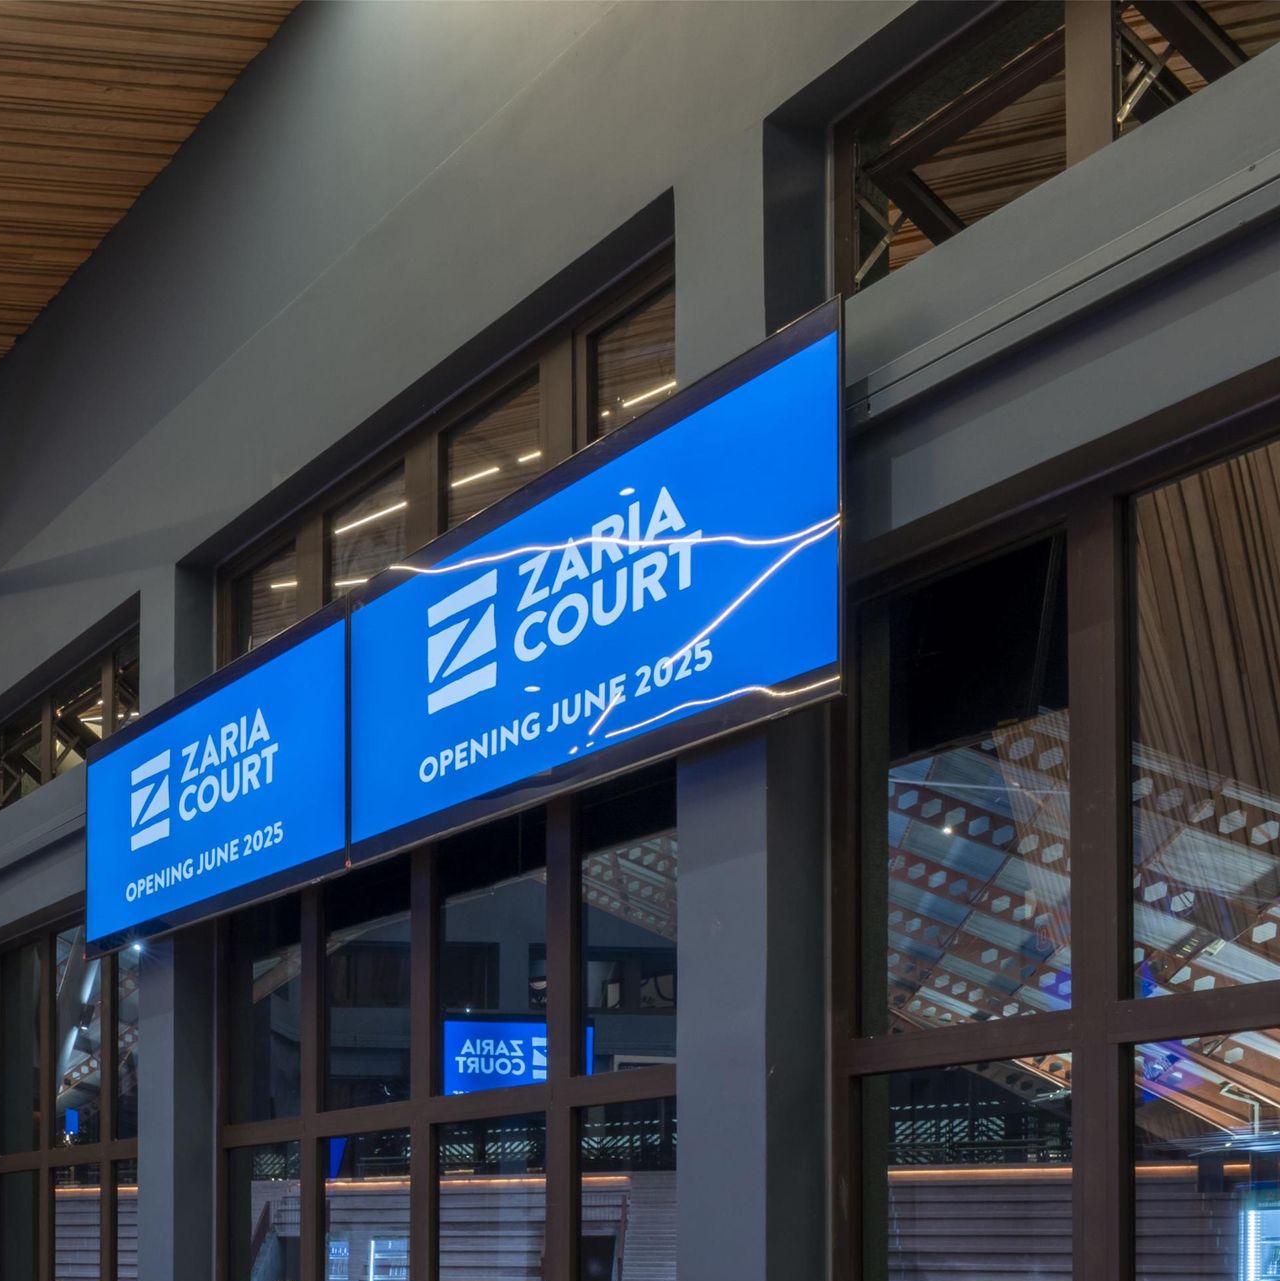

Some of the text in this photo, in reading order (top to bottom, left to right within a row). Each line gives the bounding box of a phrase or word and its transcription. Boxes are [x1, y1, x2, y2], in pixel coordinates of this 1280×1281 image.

[514, 530, 702, 662] COURT
[517, 486, 686, 612] ZARIA
[181, 708, 270, 783] ZARIA
[419, 639, 712, 783] OPENING JUNE 2025
[179, 743, 278, 821] COURT
[126, 821, 284, 902] OPENING JUNE 2025
